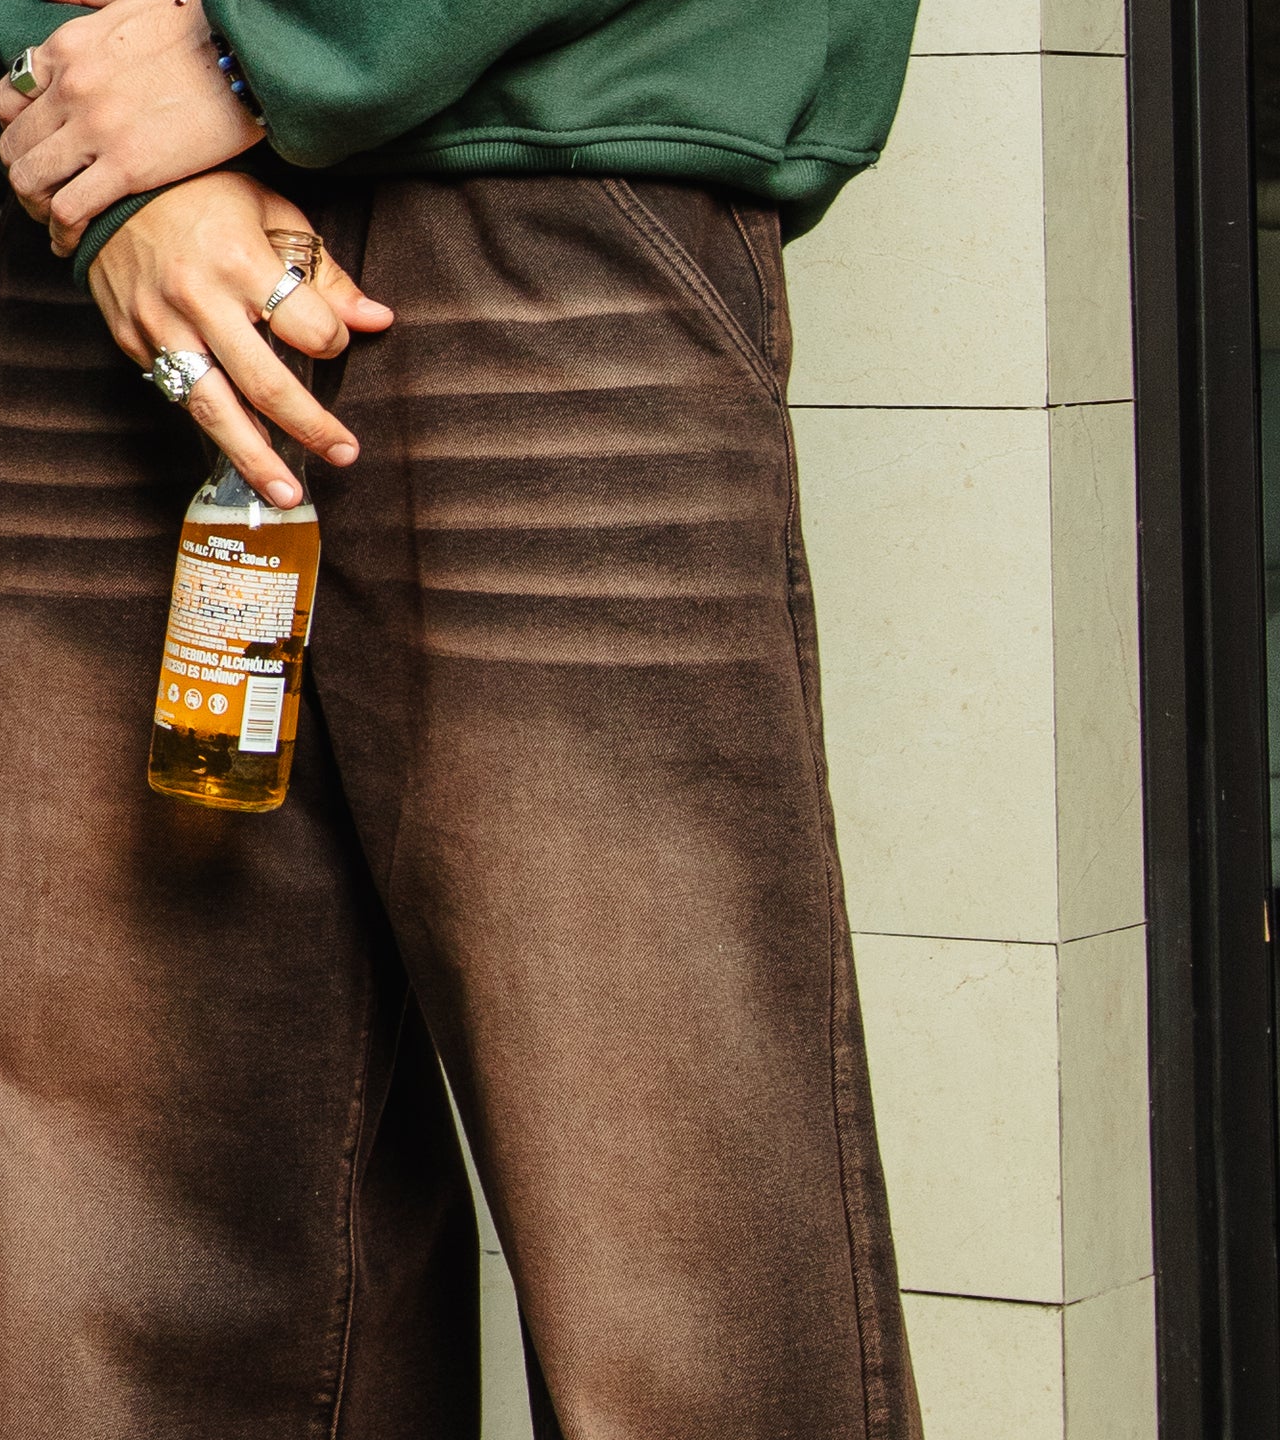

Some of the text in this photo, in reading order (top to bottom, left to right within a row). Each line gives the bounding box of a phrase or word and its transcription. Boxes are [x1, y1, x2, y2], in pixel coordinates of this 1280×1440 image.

[195, 543, 209, 557] ALC
[215, 549, 231, 562] VOL
[208, 535, 245, 552] CERVEZA
[180, 646, 219, 666] BEBIDAS
[220, 655, 284, 673] ALCOHÓLICAS
[188, 664, 199, 679] ES
